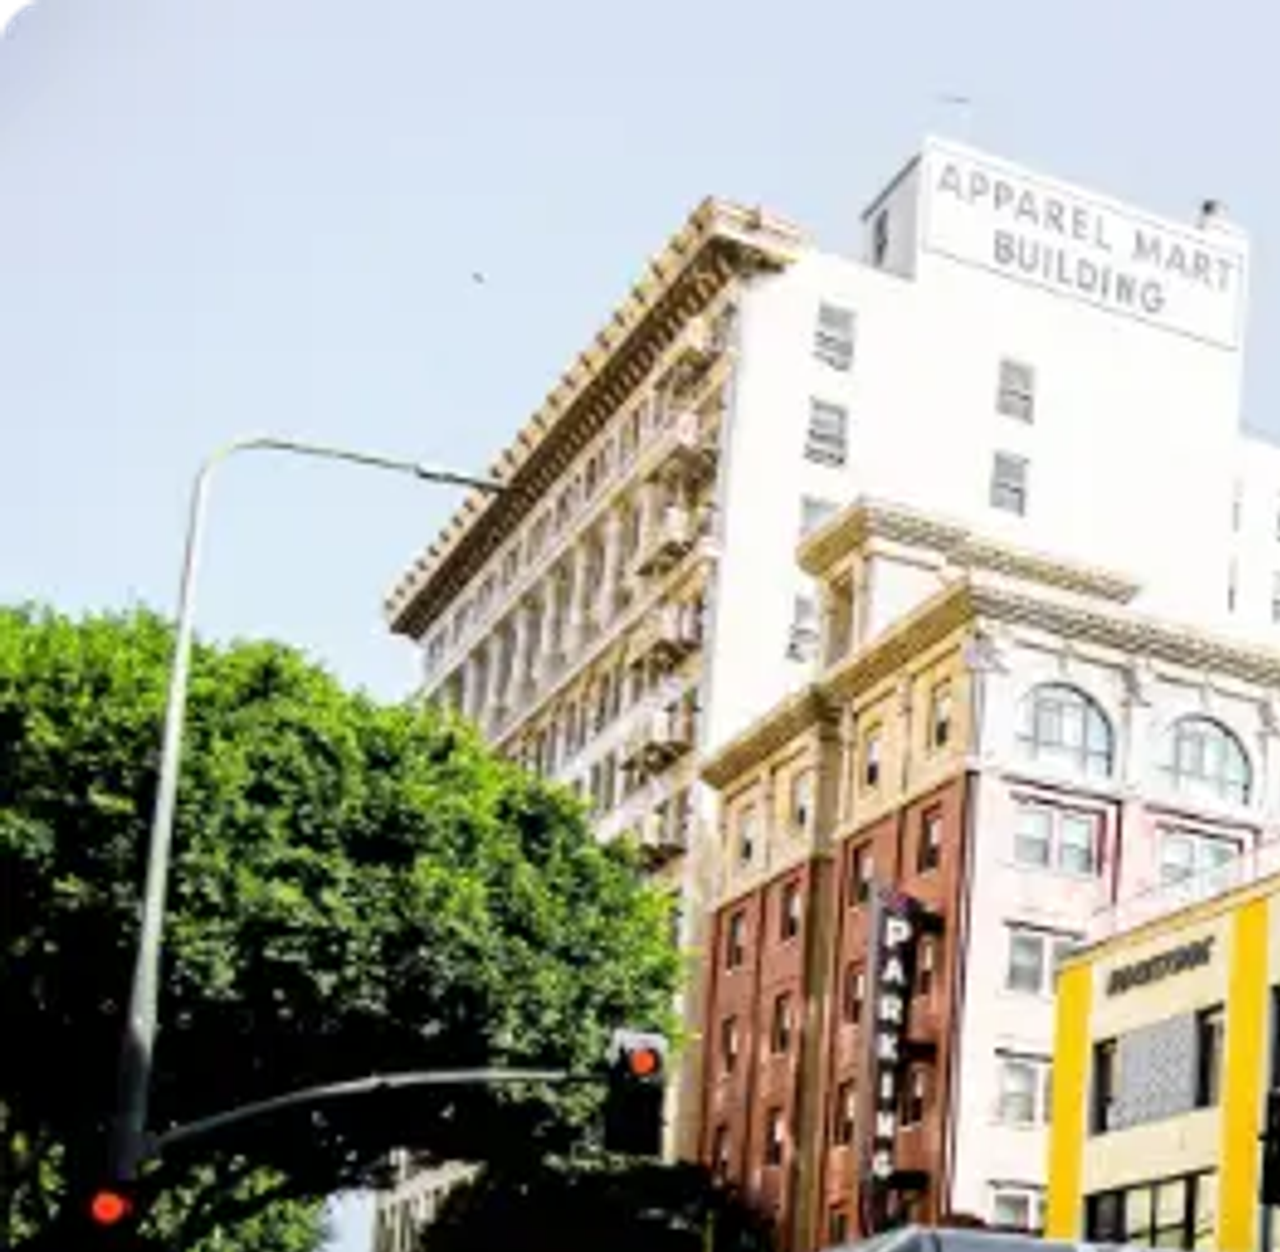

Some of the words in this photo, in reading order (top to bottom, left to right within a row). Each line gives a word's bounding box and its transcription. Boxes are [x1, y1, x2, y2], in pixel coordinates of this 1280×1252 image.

[937, 163, 1112, 251] APPAREL
[1131, 230, 1234, 292] MART
[993, 229, 1166, 315] BUILDING
[873, 918, 912, 1178] PARKING
